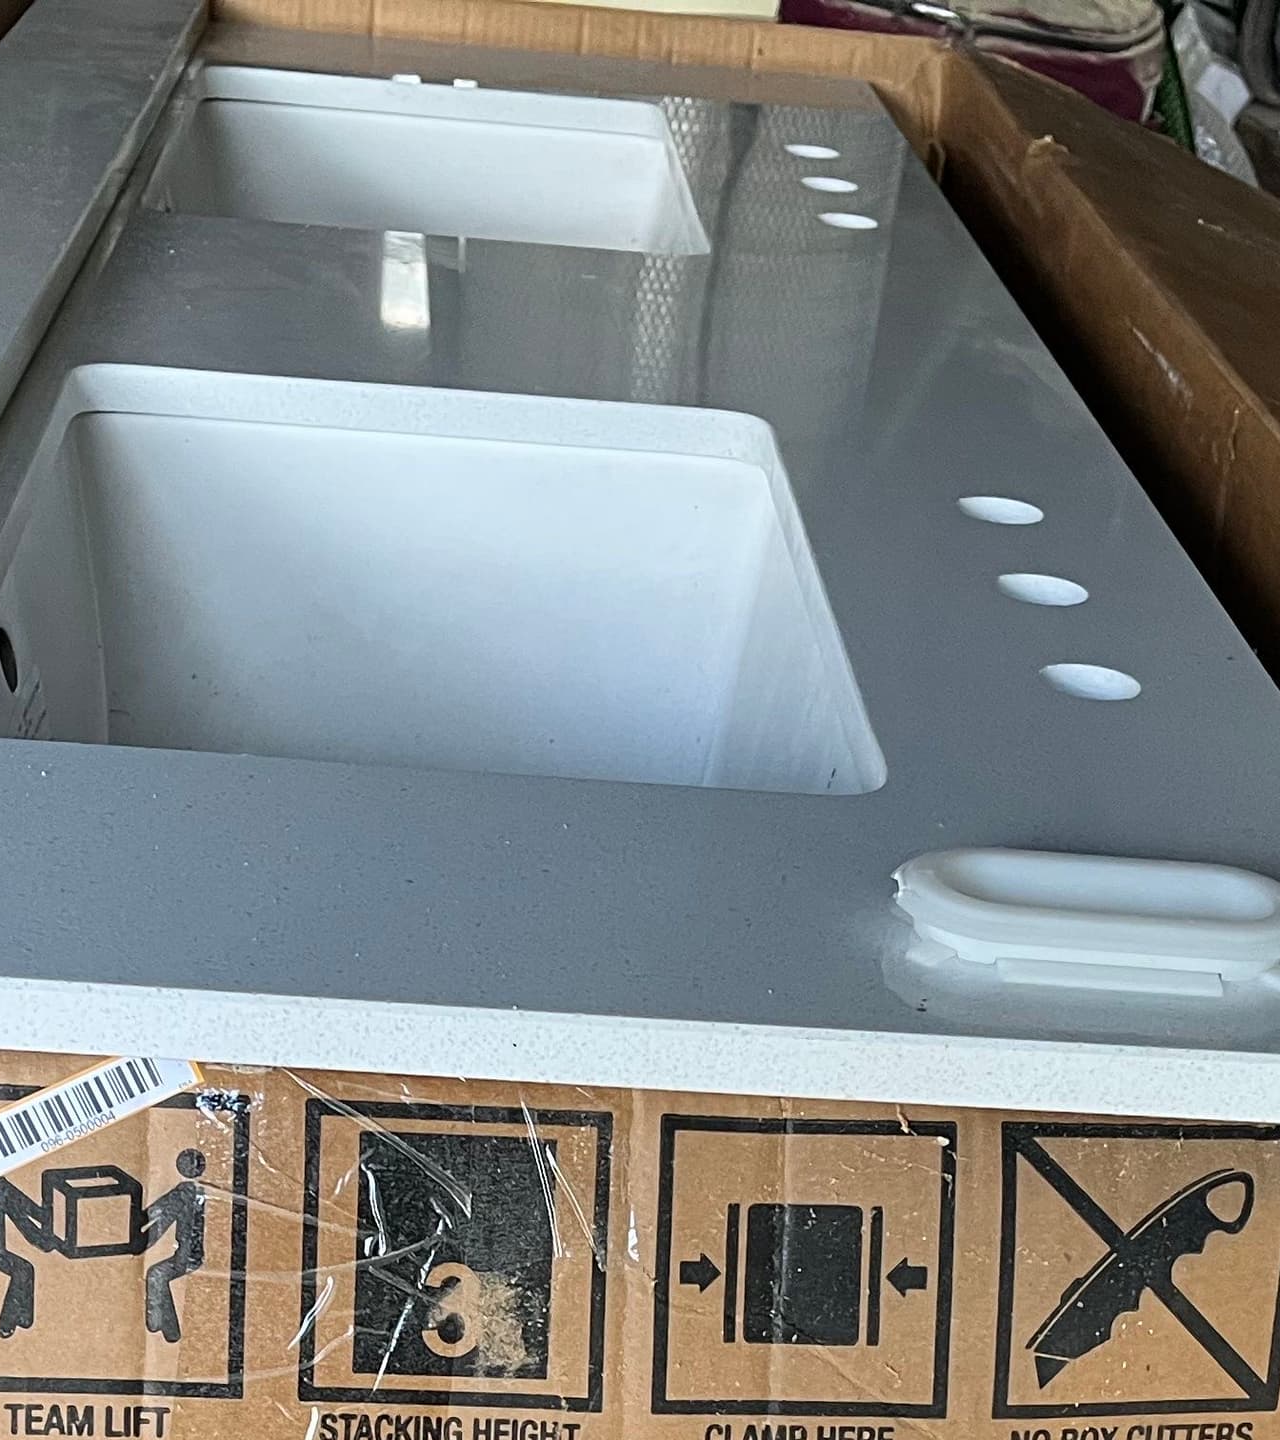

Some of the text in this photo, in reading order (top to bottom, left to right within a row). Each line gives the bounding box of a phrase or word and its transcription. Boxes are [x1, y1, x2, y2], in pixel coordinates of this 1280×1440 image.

[422, 1262, 481, 1357] 3
[3, 1403, 171, 1439] TEAM LIFT
